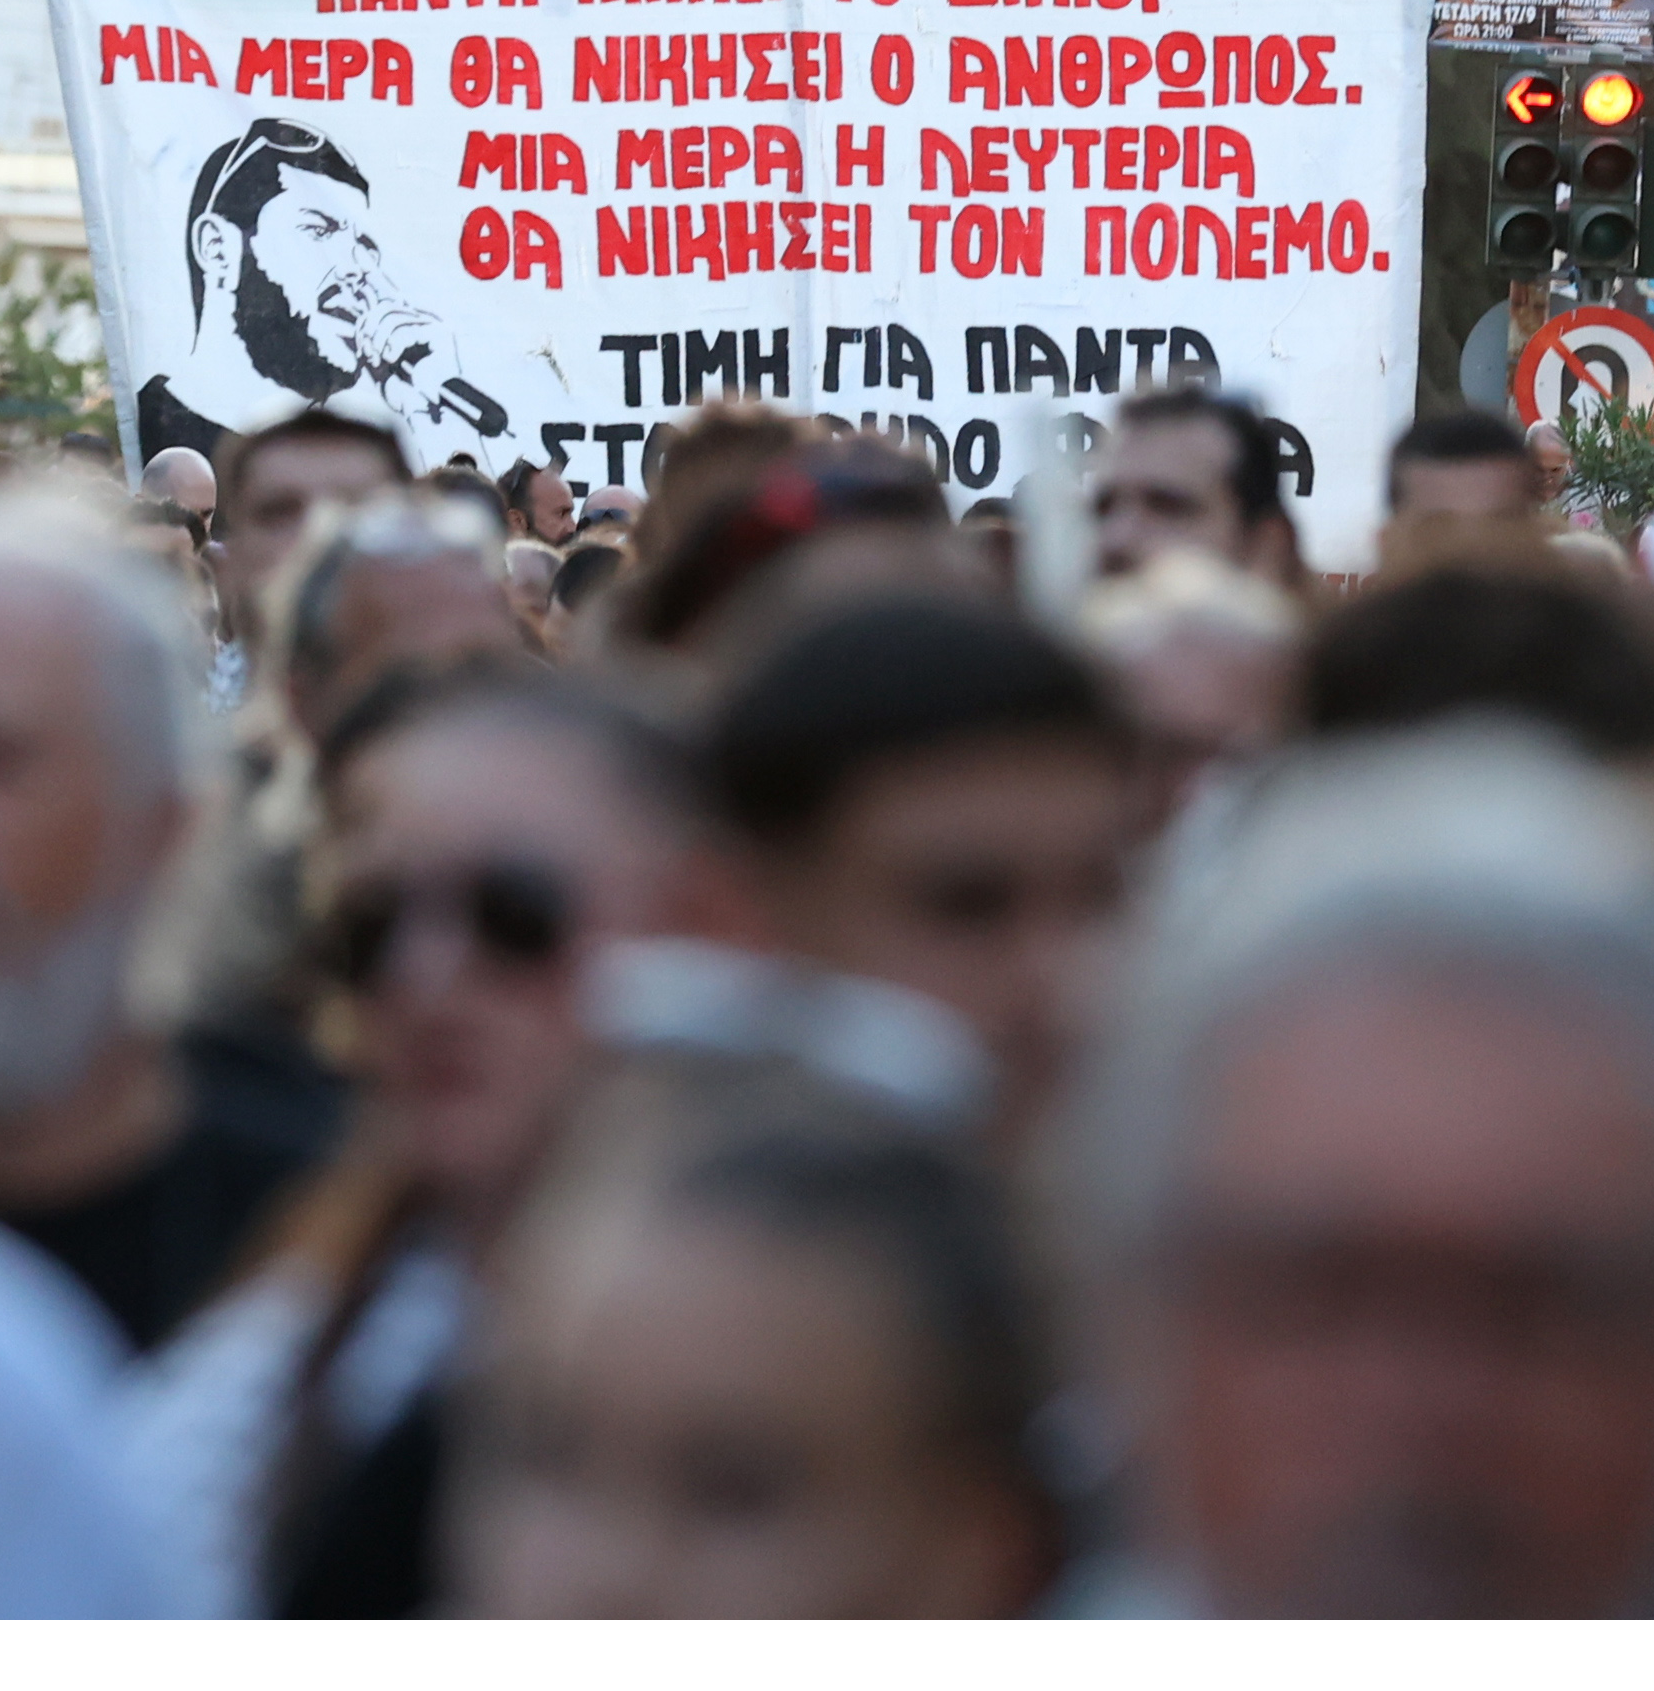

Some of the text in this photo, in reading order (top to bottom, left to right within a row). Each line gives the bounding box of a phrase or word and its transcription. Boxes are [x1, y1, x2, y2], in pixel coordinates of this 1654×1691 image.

[1435, 2, 1537, 24] ΤΕΤΑΡΤΗ 17/9
[1453, 23, 1514, 40] ΩΡΑ 21:00
[100, 24, 1363, 110] ΜΙΑ ΜΕΡΑ ΘΑ ΝΙΚΗΣΕΙ Ο ΑΝΘΡΩΠΟΣ.
[458, 124, 1255, 198] ΜΙΑ ΜΕΡΑ Η ΛΕΥΤΕΡΙΑ
[459, 199, 1390, 290] ΘΑ ΝΙΚΗΣΕΙ ΤΟΝ ΠΟΛΕΜΟ.
[600, 323, 1222, 407] ΤΙΜΗ ΓΙΑ ΠΑΝΤΑ
